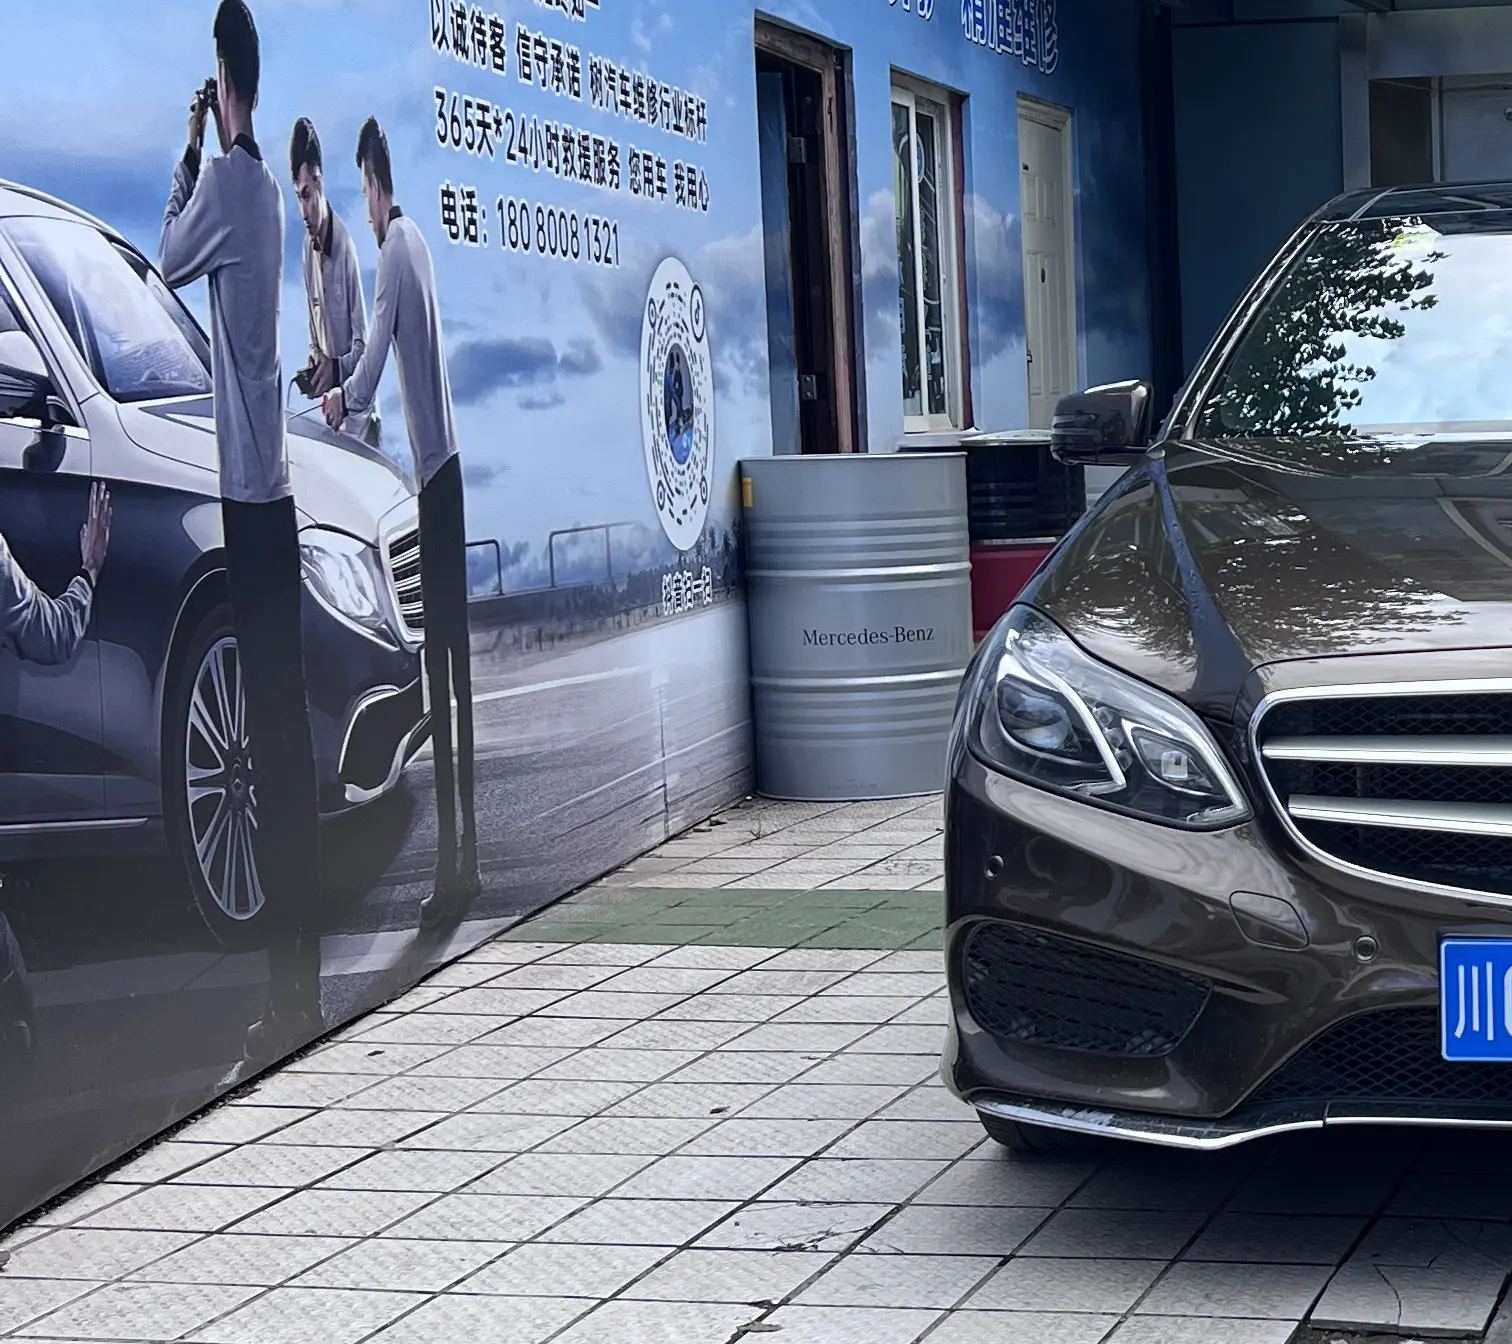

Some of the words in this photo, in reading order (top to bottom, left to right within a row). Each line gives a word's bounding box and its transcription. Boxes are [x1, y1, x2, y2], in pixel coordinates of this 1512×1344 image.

[515, 21, 583, 102] 信守承诺
[588, 51, 709, 146] 树汽车维修行业标杆
[627, 142, 668, 202] 您用车
[673, 158, 711, 213] 我用心
[496, 194, 532, 254] 180
[535, 201, 580, 263] 8008
[583, 213, 621, 269] 1321
[802, 625, 935, 646] Mercedes-Benz
